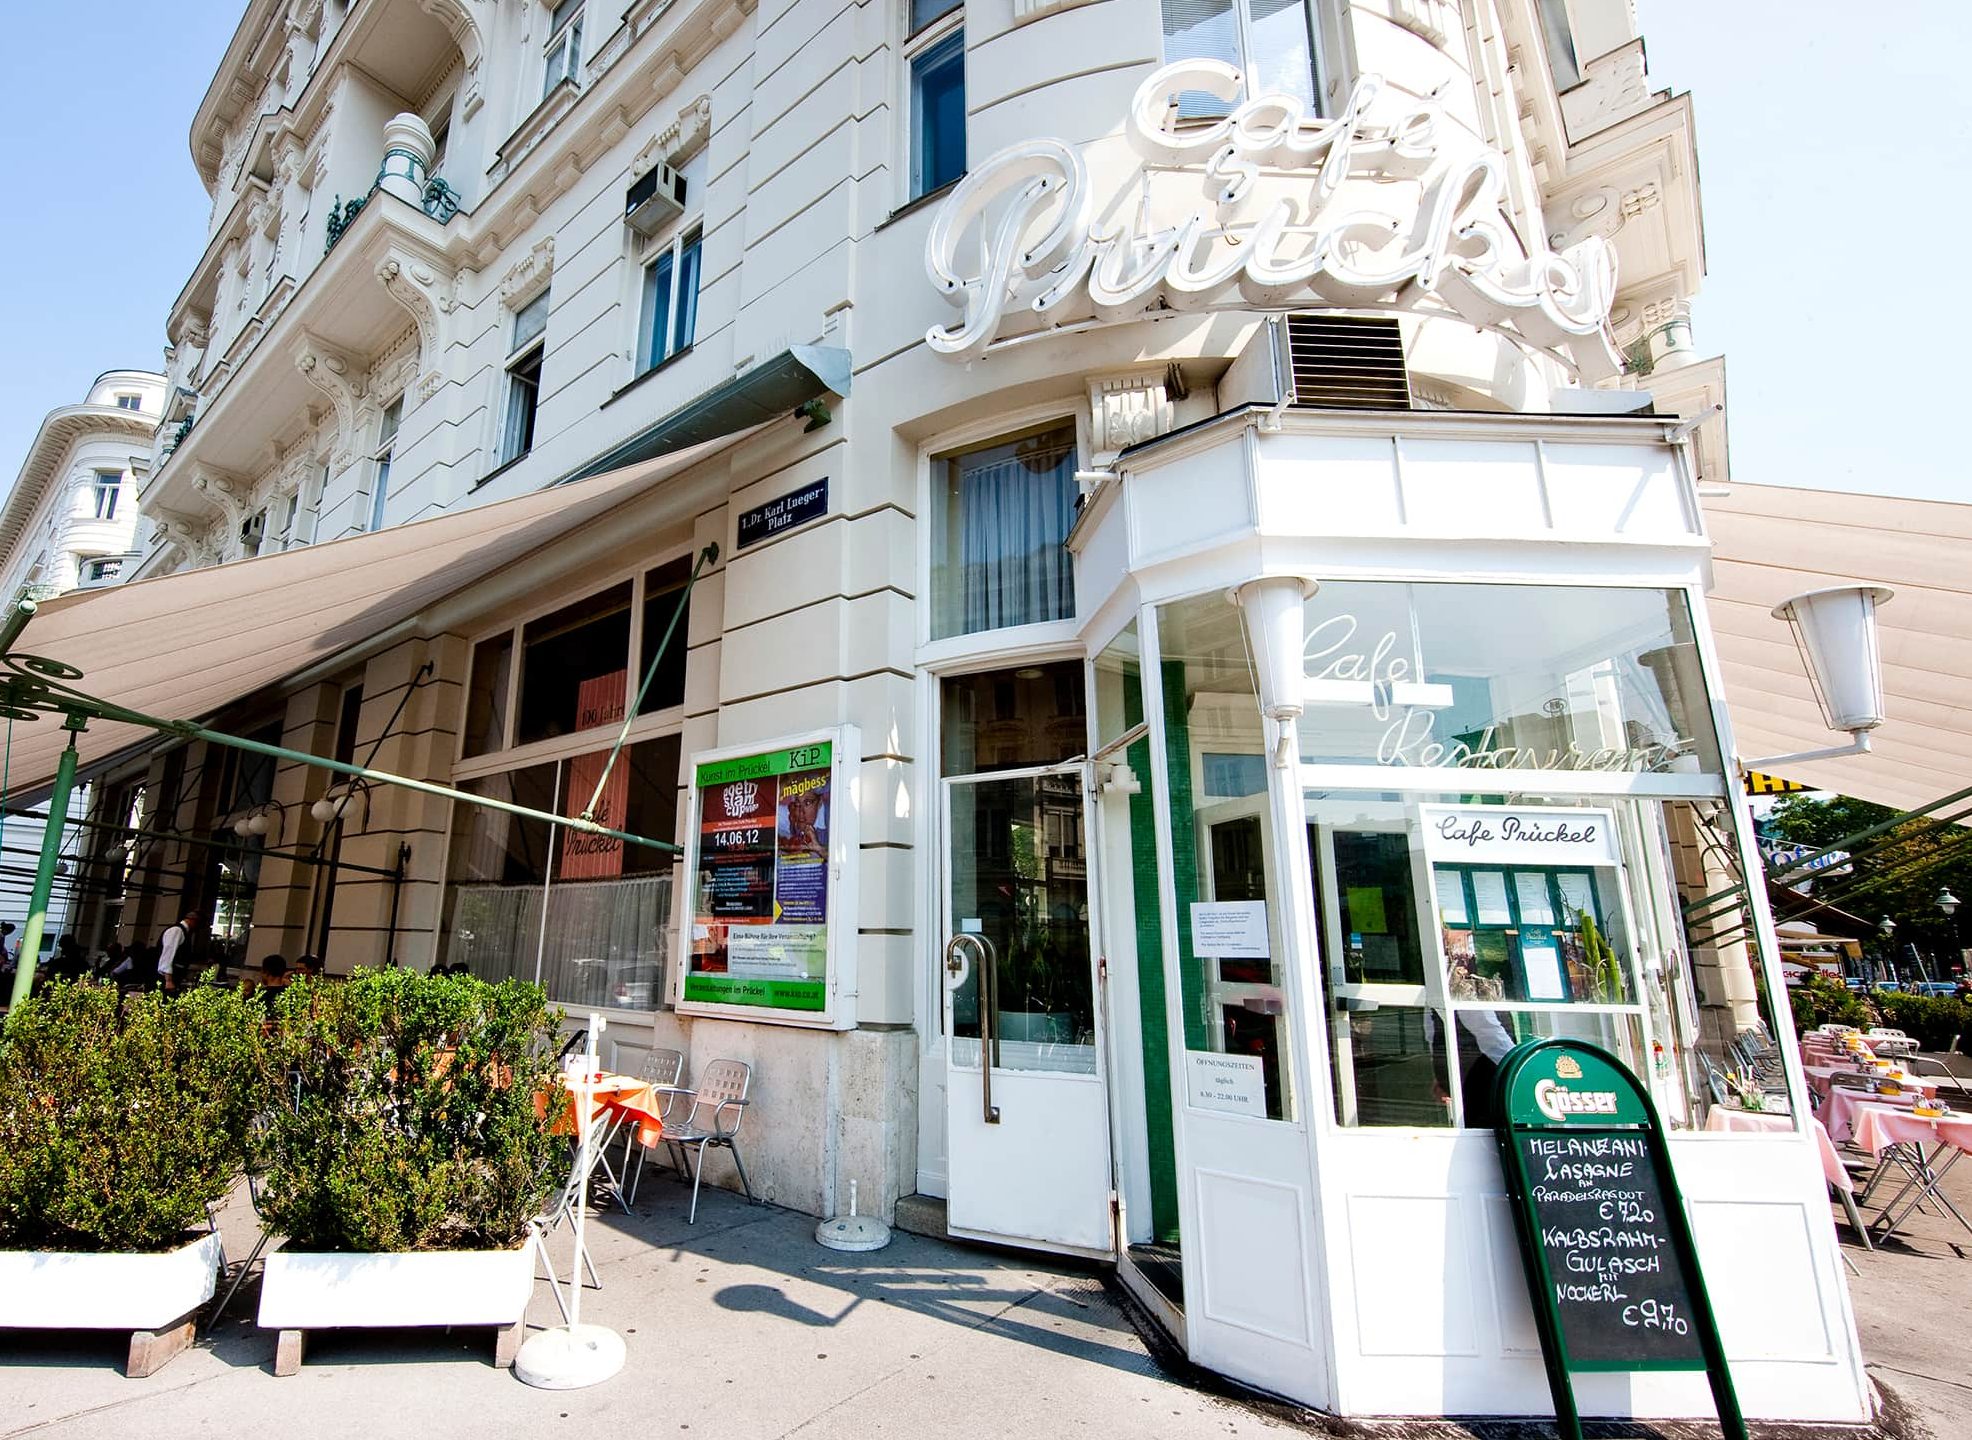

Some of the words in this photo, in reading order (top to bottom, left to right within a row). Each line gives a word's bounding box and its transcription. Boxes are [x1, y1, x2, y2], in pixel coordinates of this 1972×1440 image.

[924, 137, 1618, 372] Prückel
[764, 501, 784, 520] Karl
[768, 513, 793, 530] Platz
[701, 770, 722, 781] Kunst
[726, 768, 736, 778] im
[715, 829, 759, 846] 14.06.12
[1436, 816, 1494, 846] Cafe
[1501, 816, 1596, 843] Prückel
[1535, 1079, 1617, 1121] Gösser
[1566, 1250, 1660, 1274] GULASCH
[1599, 1272, 1619, 1283] MIT
[1556, 1283, 1628, 1305] NOCKERL
